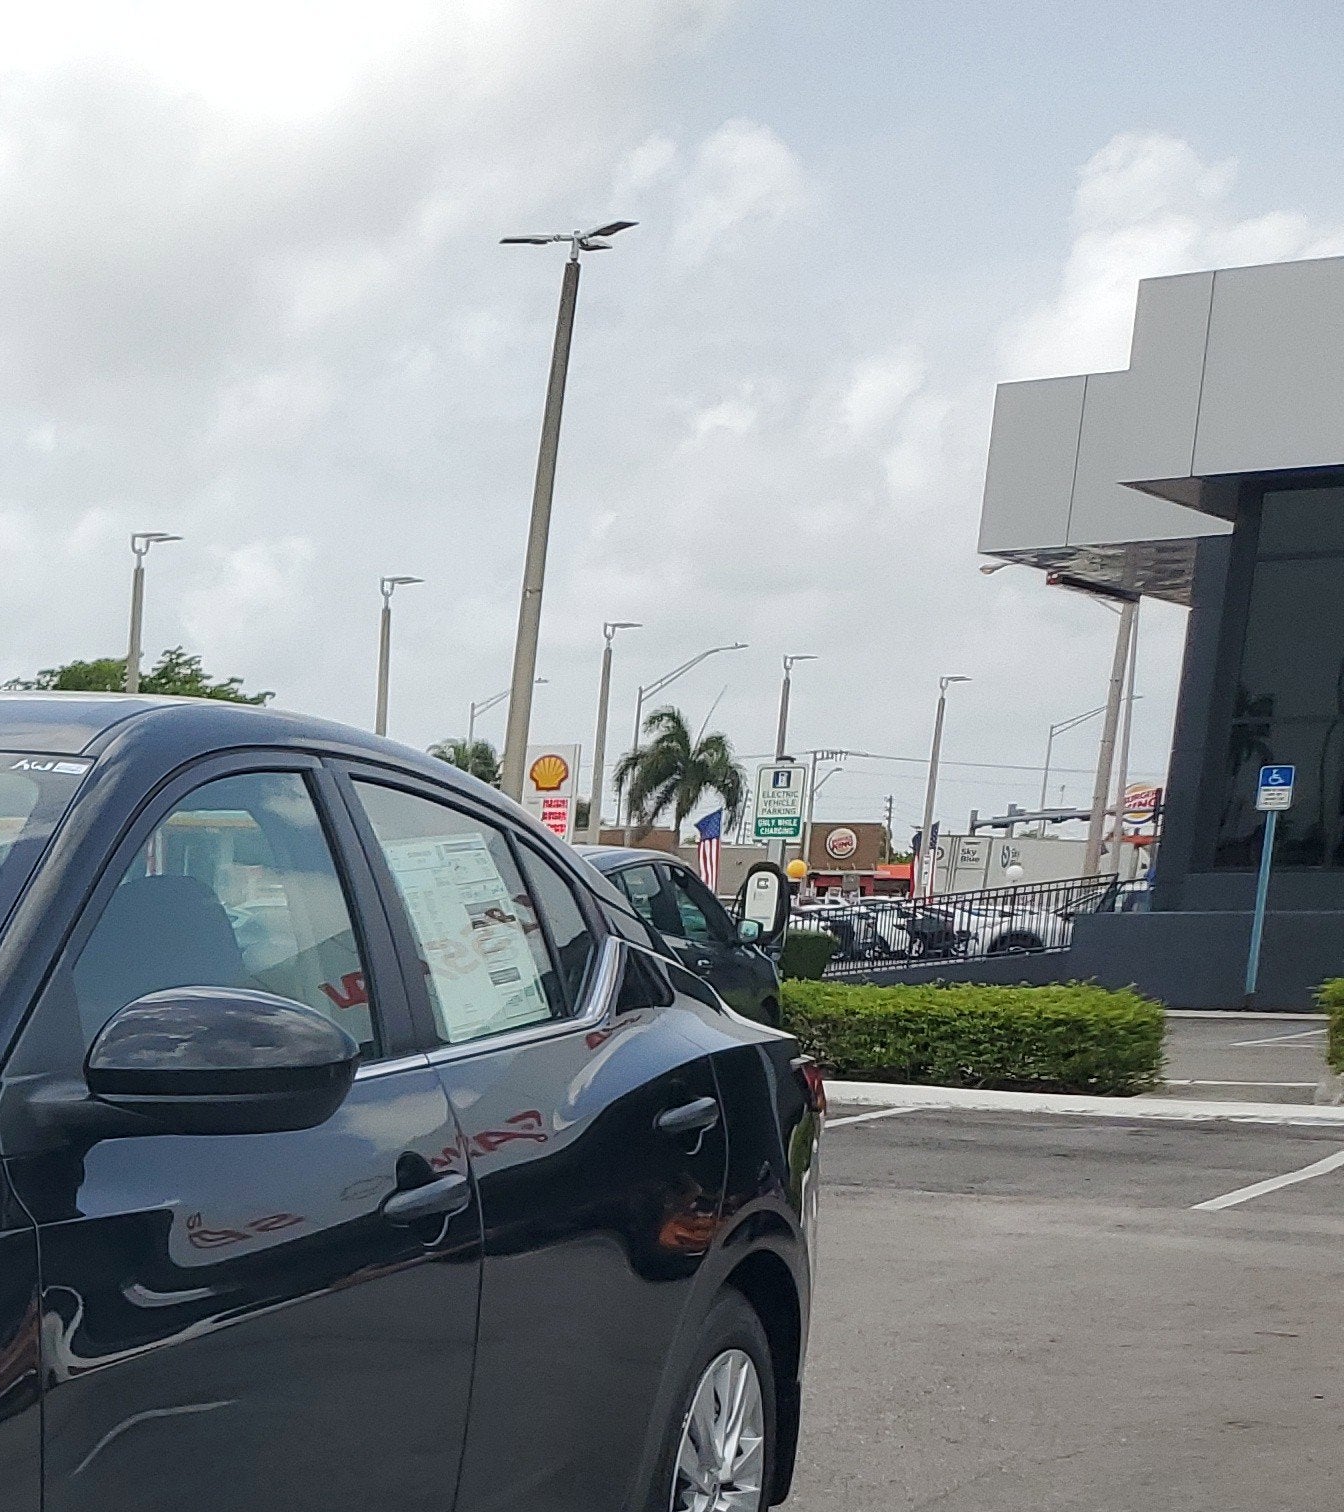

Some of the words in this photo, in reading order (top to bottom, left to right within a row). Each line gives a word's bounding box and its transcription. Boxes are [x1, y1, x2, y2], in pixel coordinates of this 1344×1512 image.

[762, 790, 798, 799] ELECTRIC
[763, 799, 796, 807] VEHICLE
[761, 807, 797, 816] PARKING
[961, 848, 977, 857] Sky
[960, 855, 981, 863] Blue
